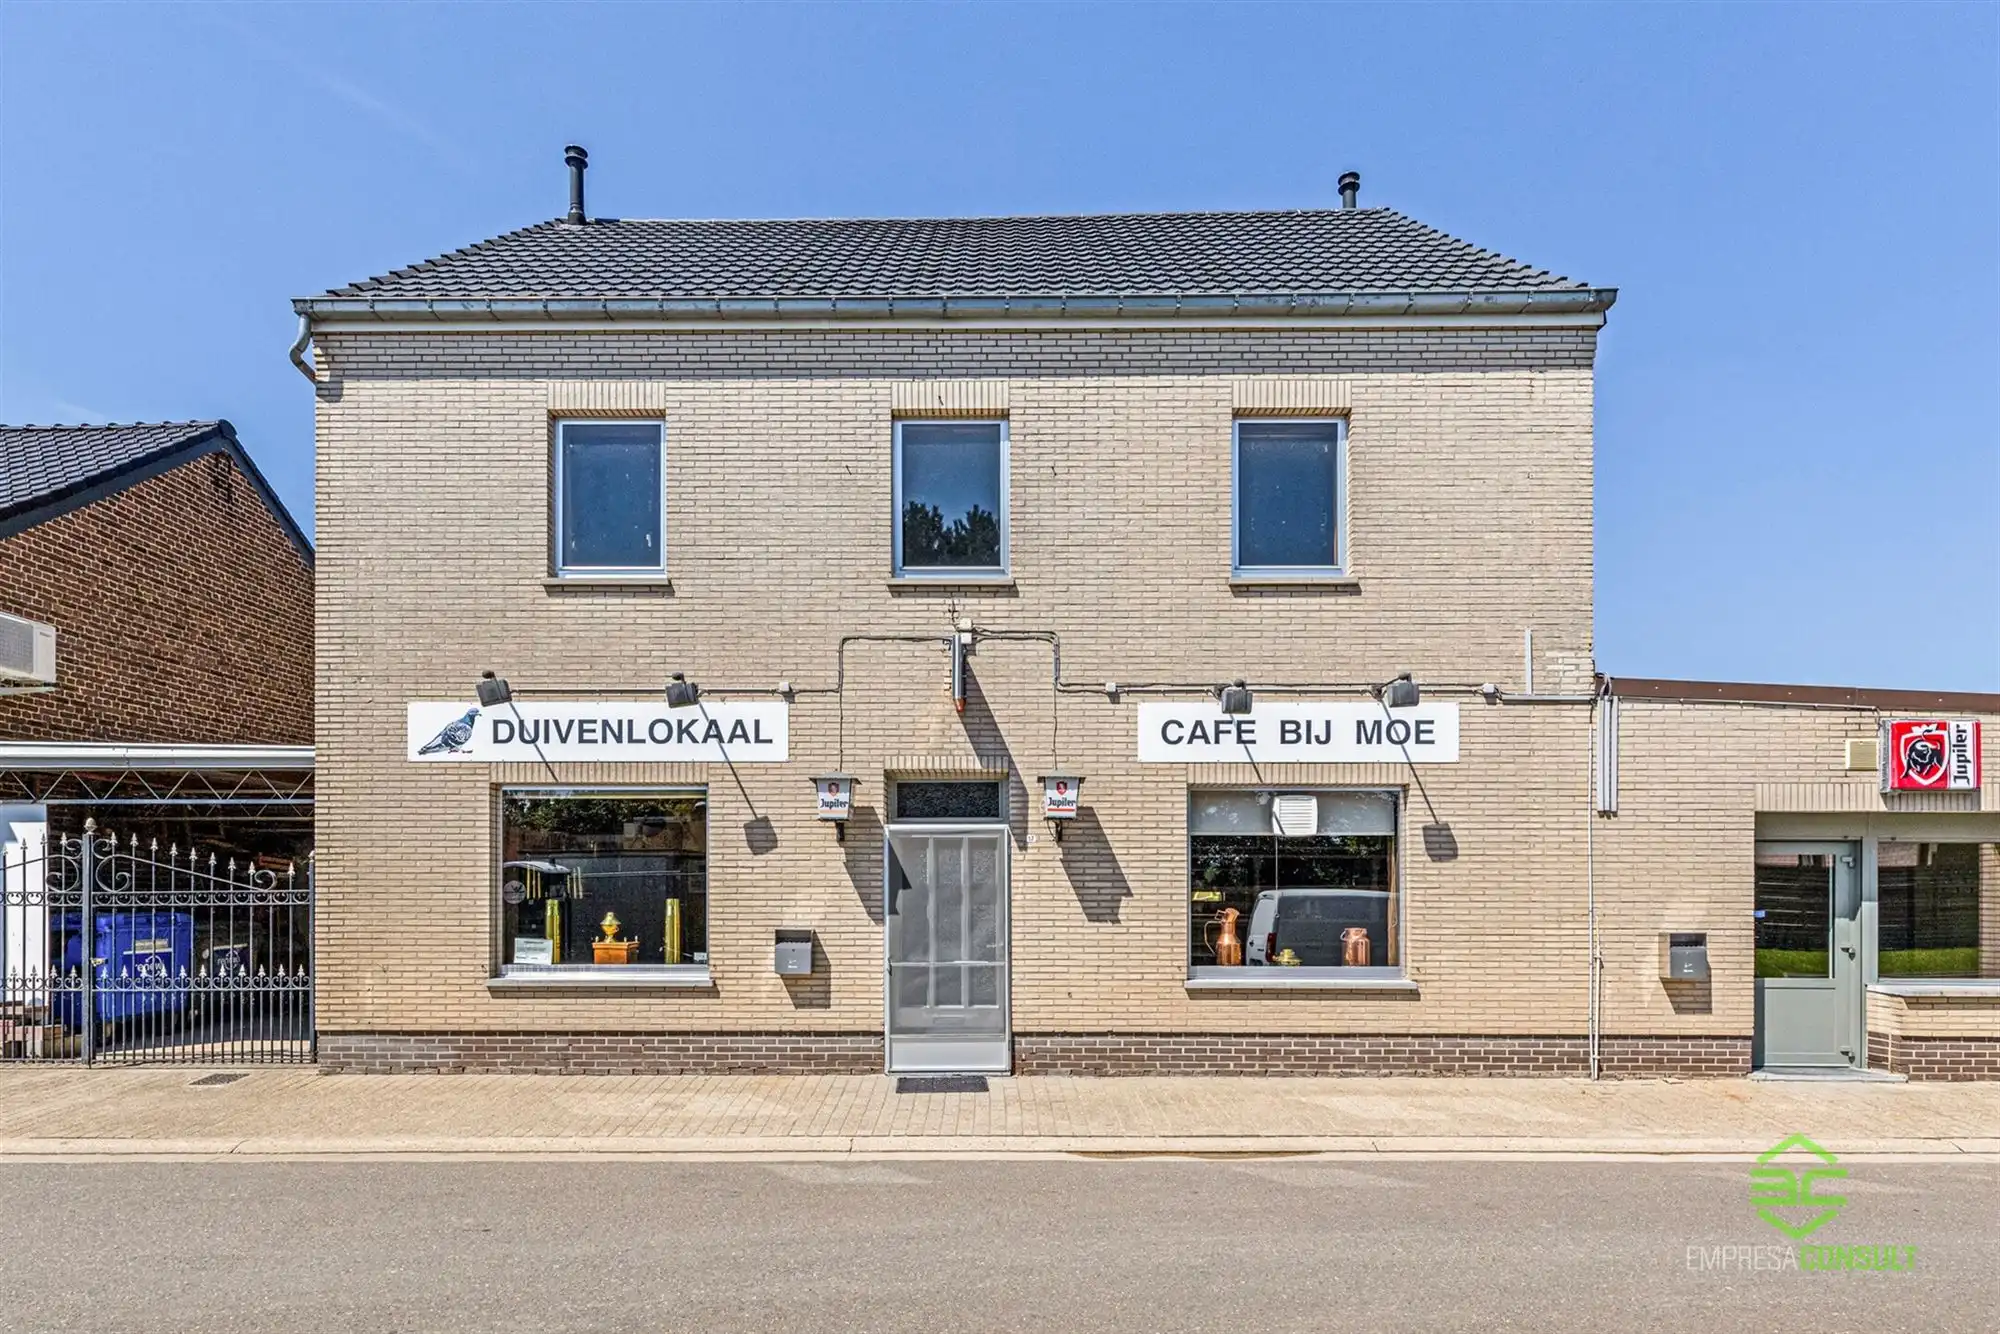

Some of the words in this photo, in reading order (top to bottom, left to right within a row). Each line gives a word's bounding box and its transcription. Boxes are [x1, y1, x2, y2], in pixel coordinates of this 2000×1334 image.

[492, 718, 773, 744] DUIVENLOKAAL
[1161, 719, 1257, 745] CAFE
[1280, 719, 1332, 745] BIJ
[1356, 719, 1435, 745] MOE
[1952, 723, 1972, 786] Jupiler
[820, 798, 849, 810] Jupiler
[1048, 796, 1076, 808] Jupiler
